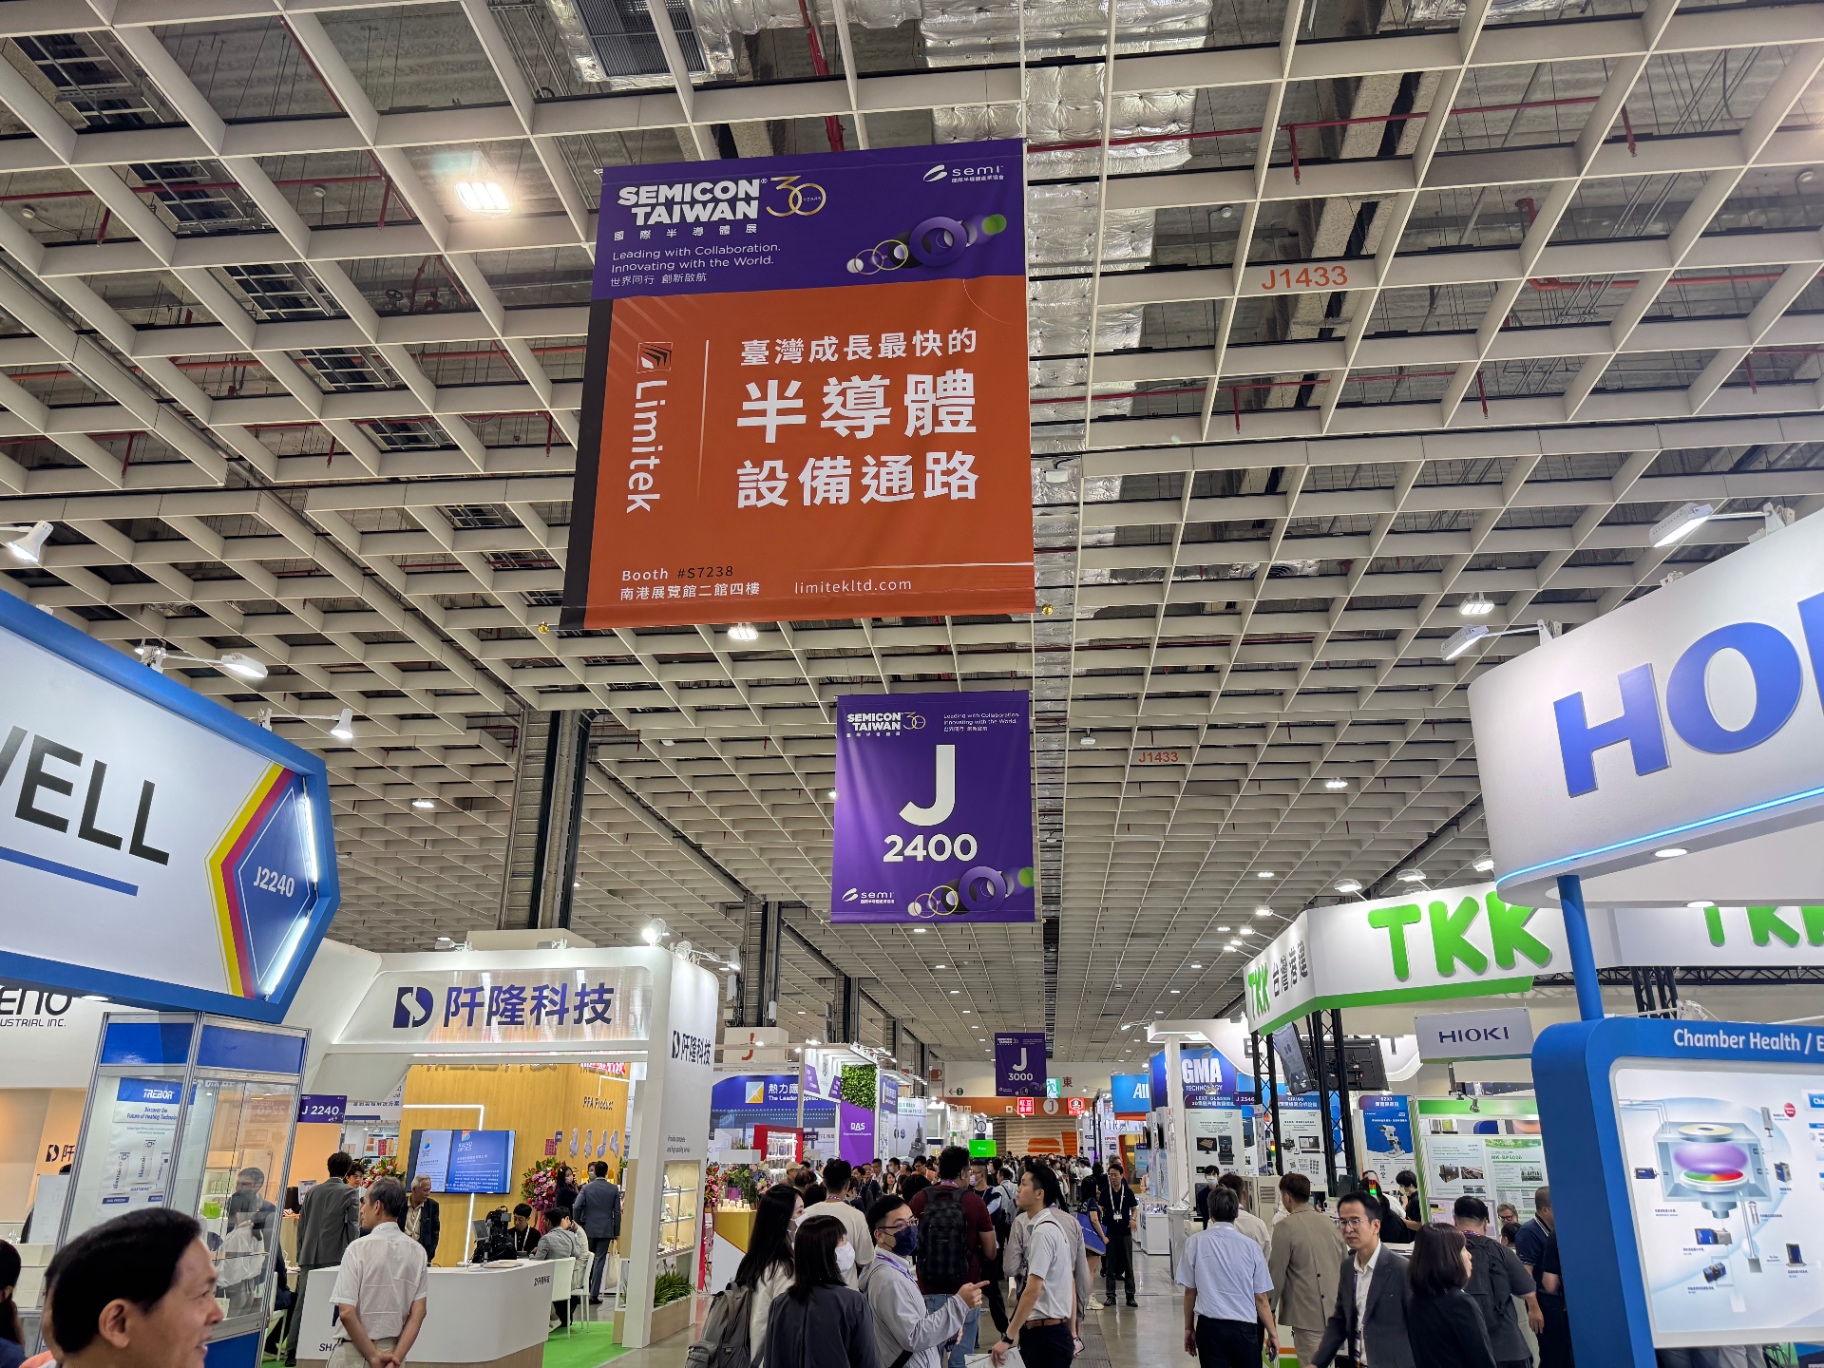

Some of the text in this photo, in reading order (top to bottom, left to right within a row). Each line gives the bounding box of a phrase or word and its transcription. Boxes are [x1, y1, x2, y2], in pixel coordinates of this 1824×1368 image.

[952, 165, 1000, 176] semi
[631, 200, 758, 226] TAIWAN
[614, 223, 758, 241] 國際半導體展
[612, 243, 781, 261] Leading with Collaboration.
[611, 255, 774, 274] Innovating with the World.
[610, 272, 707, 287] 世界同行 創新啟航
[1261, 265, 1348, 290] J1433
[740, 327, 978, 367] 臺灣成長最快的
[736, 369, 977, 443] 半導體
[626, 380, 667, 513] Limitek
[736, 450, 979, 509] 設備通路
[622, 565, 734, 582] Booth #S7238
[620, 581, 760, 600] 南港展覽館二館四樓
[795, 578, 912, 595] limitekltd.com
[847, 712, 901, 723] SEMICON
[852, 721, 901, 731] TAIWAN
[1138, 751, 1179, 763] J1433
[898, 745, 956, 826] J
[883, 833, 978, 862] 2400
[253, 865, 296, 898] J2240
[861, 891, 893, 899] semi
[1367, 891, 1553, 981] TKK
[1248, 962, 1271, 1021] TKK
[443, 982, 615, 1028] 阡隆科技
[47, 1018, 67, 1027] INC.
[1438, 1025, 1510, 1044] HIOKI
[1673, 1028, 1746, 1048] Chamber
[1749, 1032, 1801, 1051] Health
[680, 1033, 711, 1065] 阡隆科技
[1012, 1047, 1028, 1071] J
[1008, 1072, 1034, 1081] 3000
[1165, 1058, 1223, 1083] GMA
[1062, 1076, 1073, 1088] 東
[143, 1088, 173, 1100] TREBOR
[301, 1106, 340, 1116] J 2240
[1048, 1100, 1055, 1112] J
[850, 1122, 866, 1131] DAS
